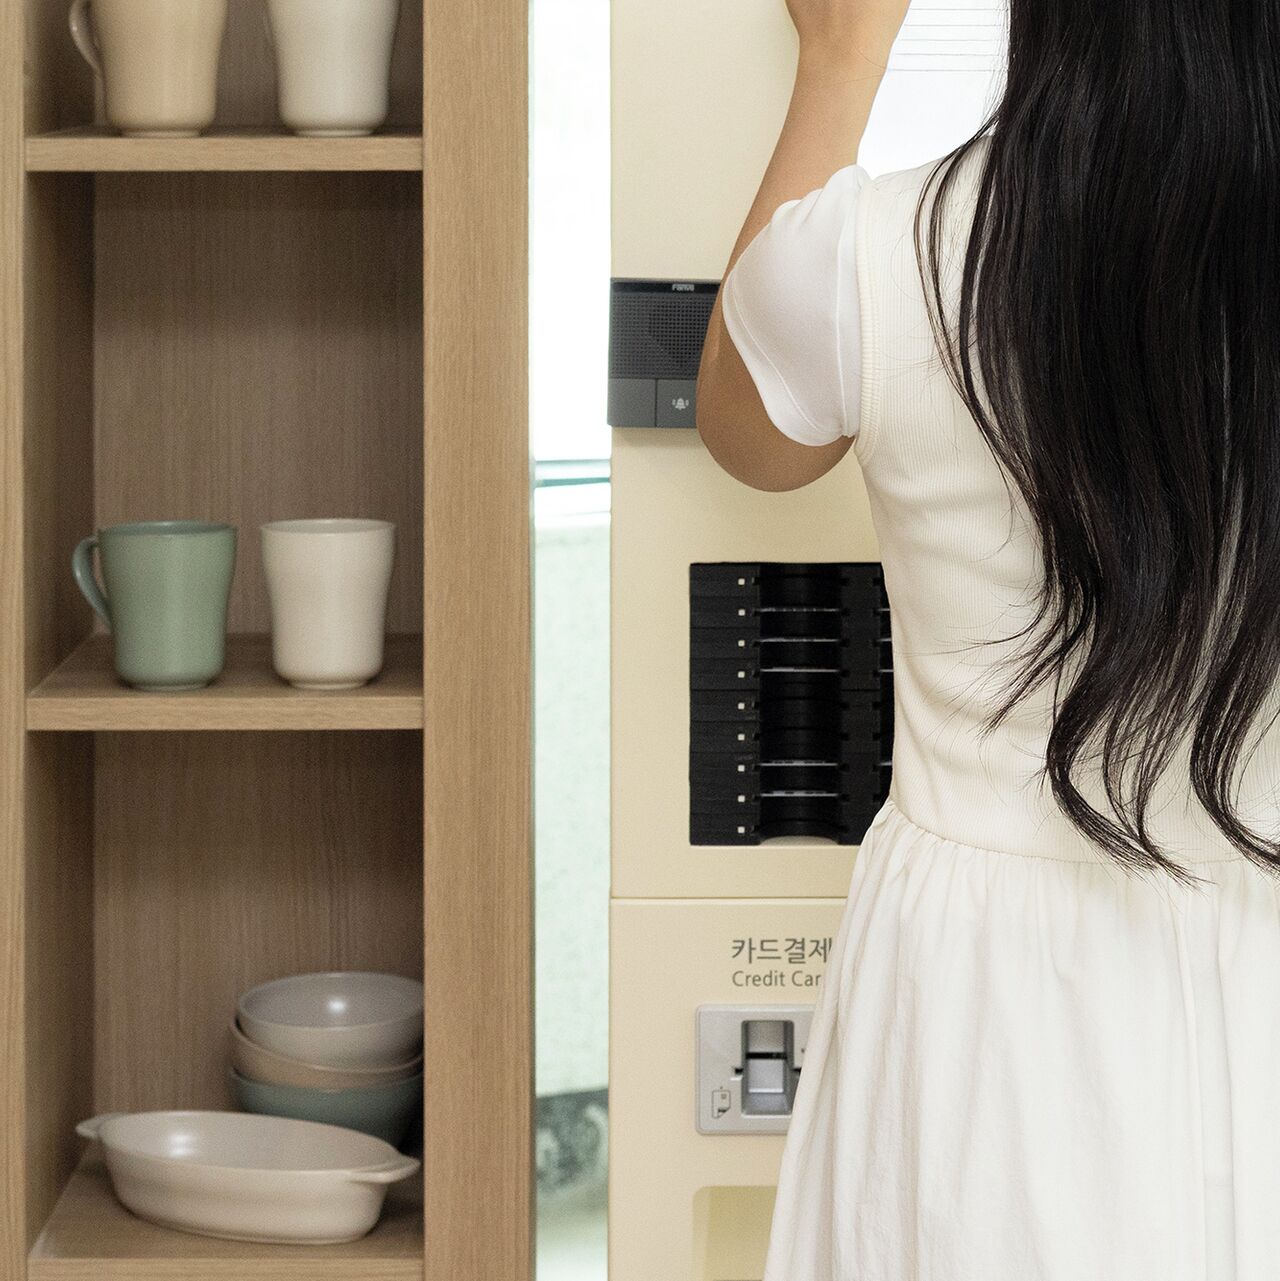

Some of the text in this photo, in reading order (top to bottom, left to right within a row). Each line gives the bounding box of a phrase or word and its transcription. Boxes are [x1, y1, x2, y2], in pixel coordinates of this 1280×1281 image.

[732, 937, 833, 965] 카드결제
[732, 970, 822, 987] Credit Car
